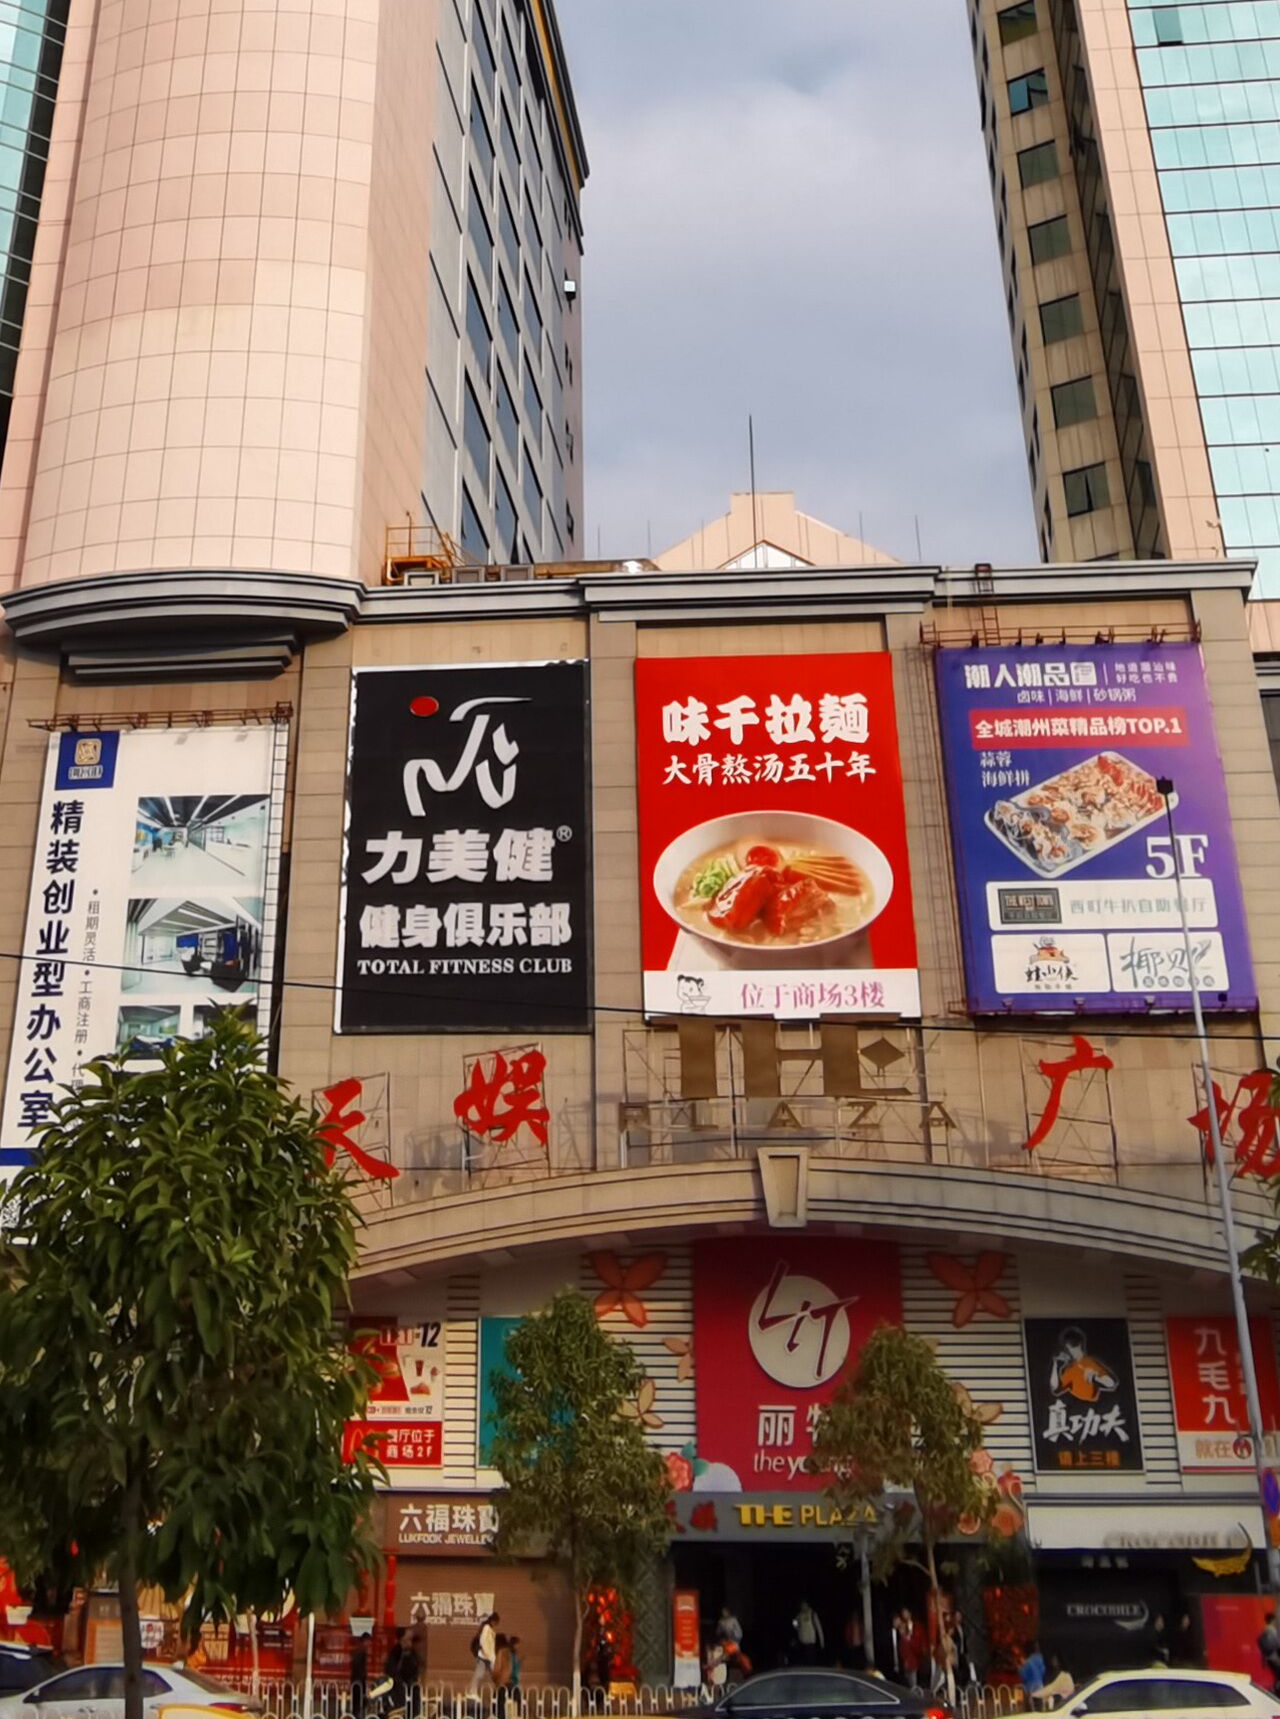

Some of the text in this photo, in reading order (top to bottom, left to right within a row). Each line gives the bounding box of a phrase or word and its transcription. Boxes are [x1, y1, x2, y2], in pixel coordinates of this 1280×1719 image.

[661, 692, 870, 747] 味千拉麵
[662, 751, 877, 786] 大骨熬汤五十年
[361, 827, 556, 884] 力美健
[1145, 834, 1209, 879] 5F
[359, 901, 572, 949] 健身俱乐部
[17, 799, 85, 1128] 精装创业型办公室
[357, 958, 572, 975] TOTAL FITNESS CLUB
[741, 980, 885, 1010] 位于商场3楼
[1042, 1399, 1130, 1444] 真功夫
